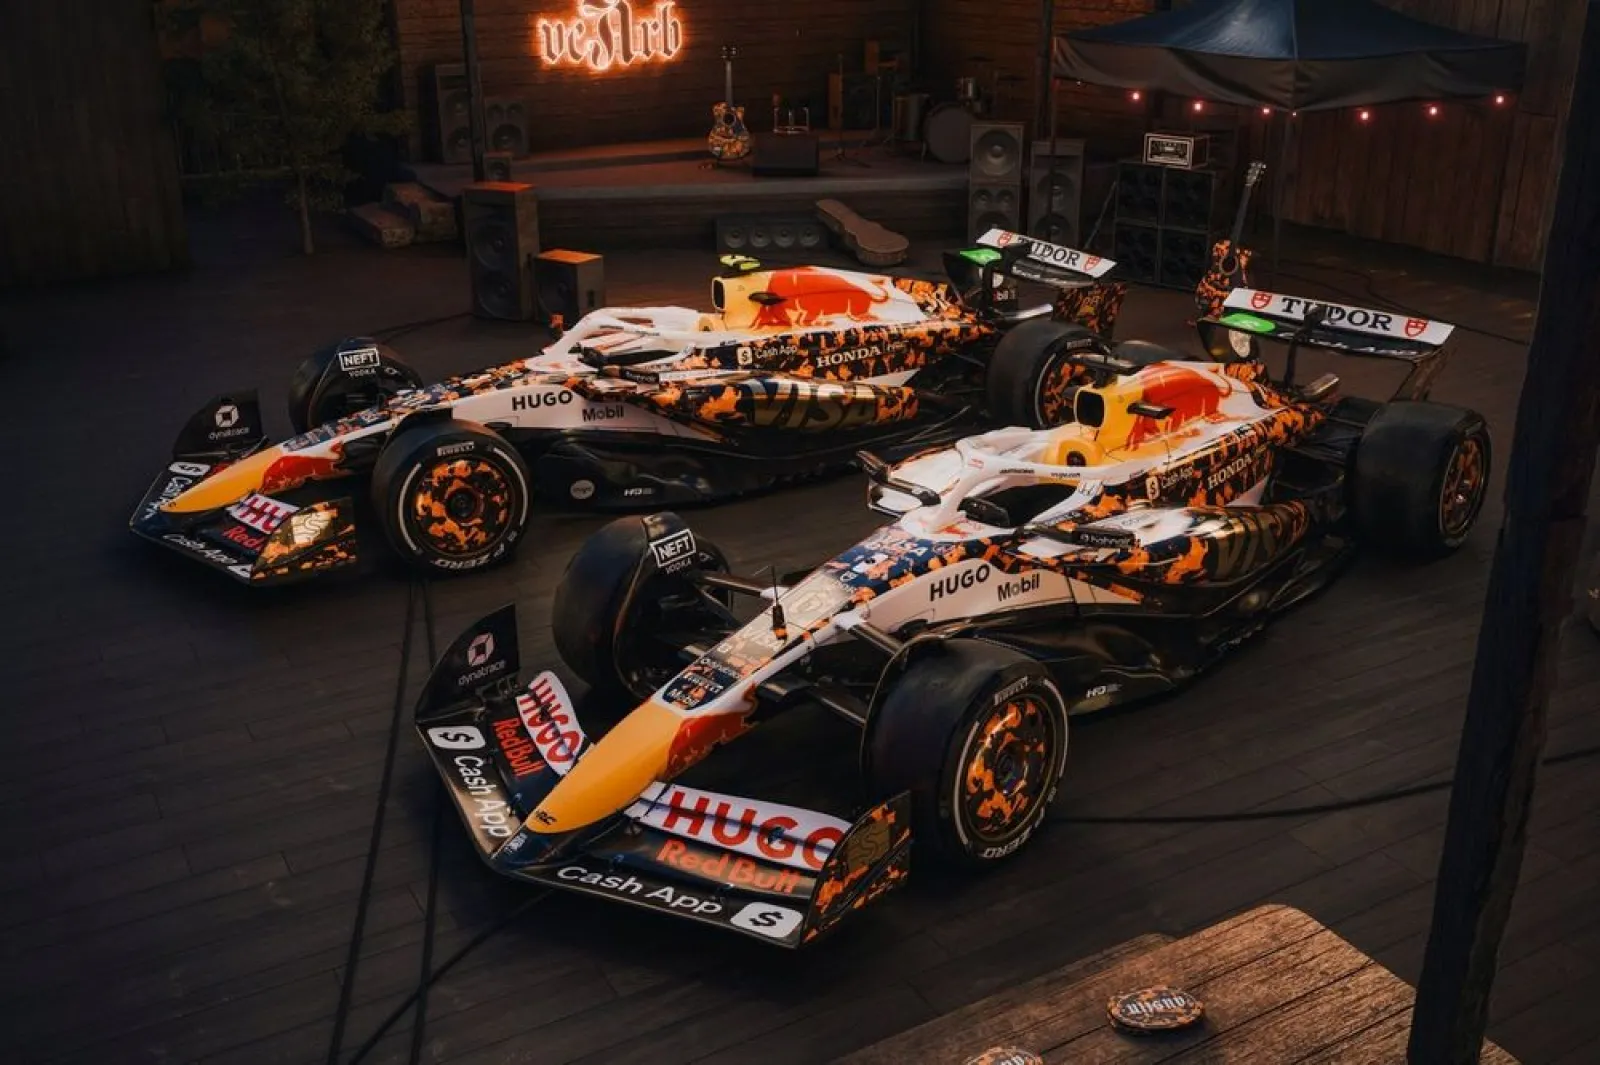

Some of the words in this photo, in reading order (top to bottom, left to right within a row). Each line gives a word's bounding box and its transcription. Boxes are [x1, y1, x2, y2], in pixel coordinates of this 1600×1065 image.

[343, 352, 375, 366] NEFT
[816, 345, 882, 368] HONDA
[511, 390, 574, 412] HUGO
[581, 405, 625, 423] Mobil
[746, 378, 878, 428] VISA
[1207, 454, 1252, 491] HONDA
[658, 536, 690, 561] NEFT
[929, 563, 991, 602] HUGO
[996, 573, 1041, 602] Mobil
[457, 658, 508, 687] dynatrace
[518, 677, 581, 764] HUGO
[453, 754, 498, 796] Cash
[473, 799, 514, 838] App
[556, 865, 643, 896] Cash
[648, 885, 723, 916] App
